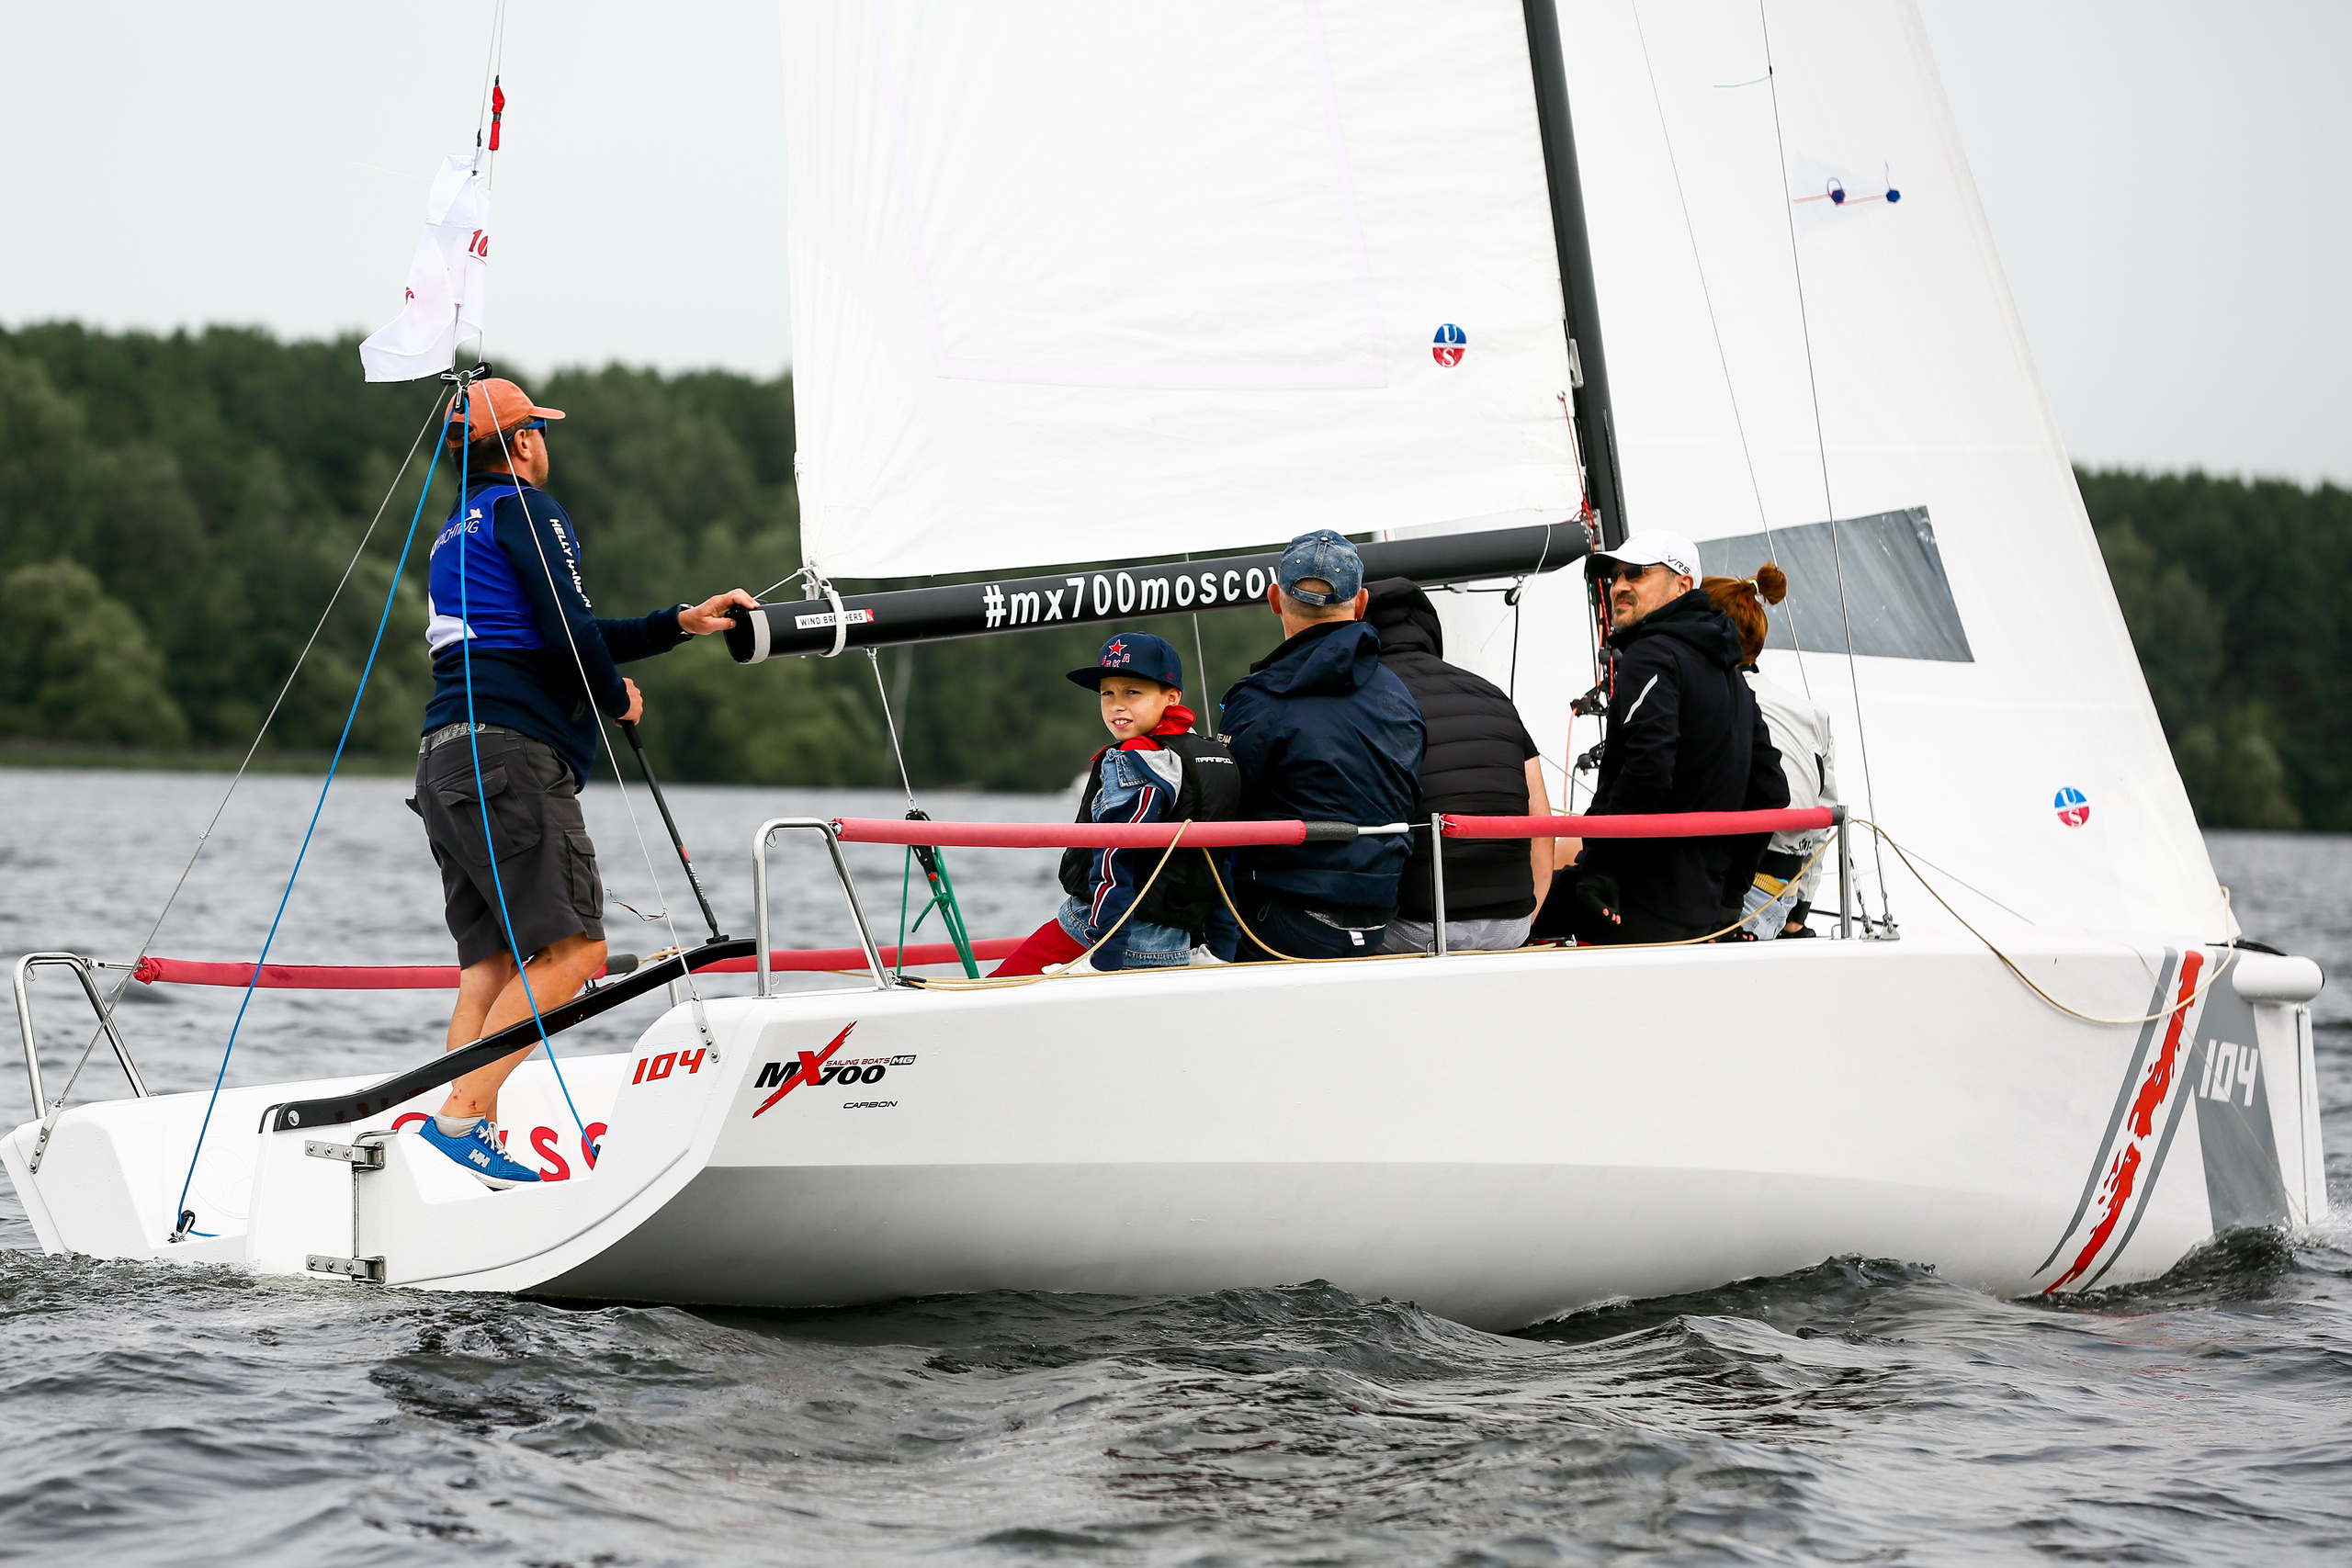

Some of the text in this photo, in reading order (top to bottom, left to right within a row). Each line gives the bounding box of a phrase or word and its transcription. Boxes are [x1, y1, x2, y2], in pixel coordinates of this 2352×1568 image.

[548, 518, 573, 557] HELLY
[1668, 555, 1691, 574] VRS
[799, 613, 864, 626] WIND BRHERS
[632, 1048, 707, 1085] 104
[825, 1058, 860, 1066] SAILING
[861, 1057, 891, 1066] BOATS
[2199, 1039, 2258, 1107] 104
[842, 1100, 899, 1109] CARBON
